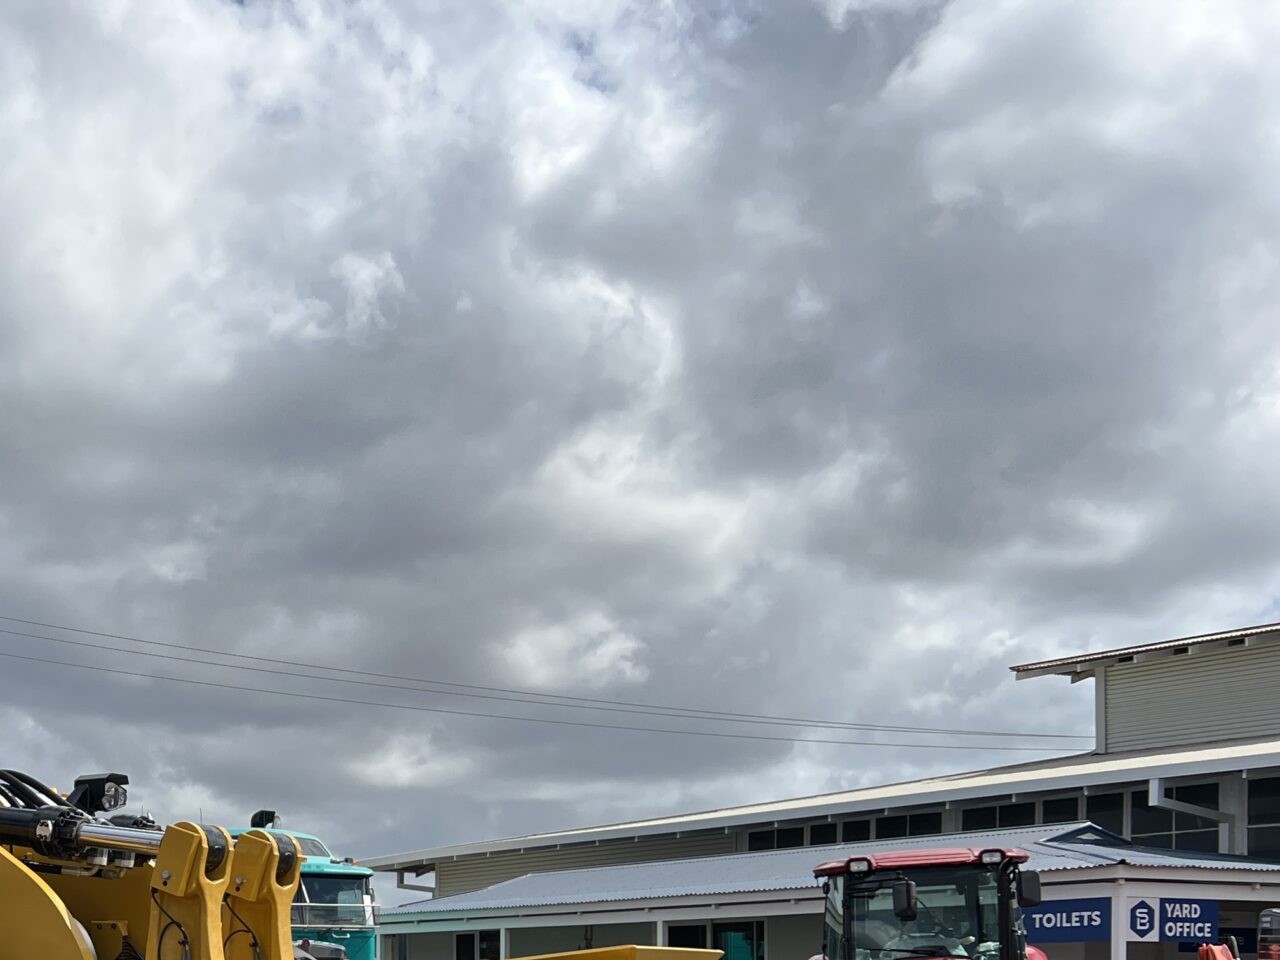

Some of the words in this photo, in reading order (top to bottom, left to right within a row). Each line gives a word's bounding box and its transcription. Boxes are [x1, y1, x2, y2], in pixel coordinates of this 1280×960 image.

[1165, 903, 1201, 918] YARD
[1032, 911, 1101, 928] TOILETS
[1165, 922, 1212, 938] OFFICE
